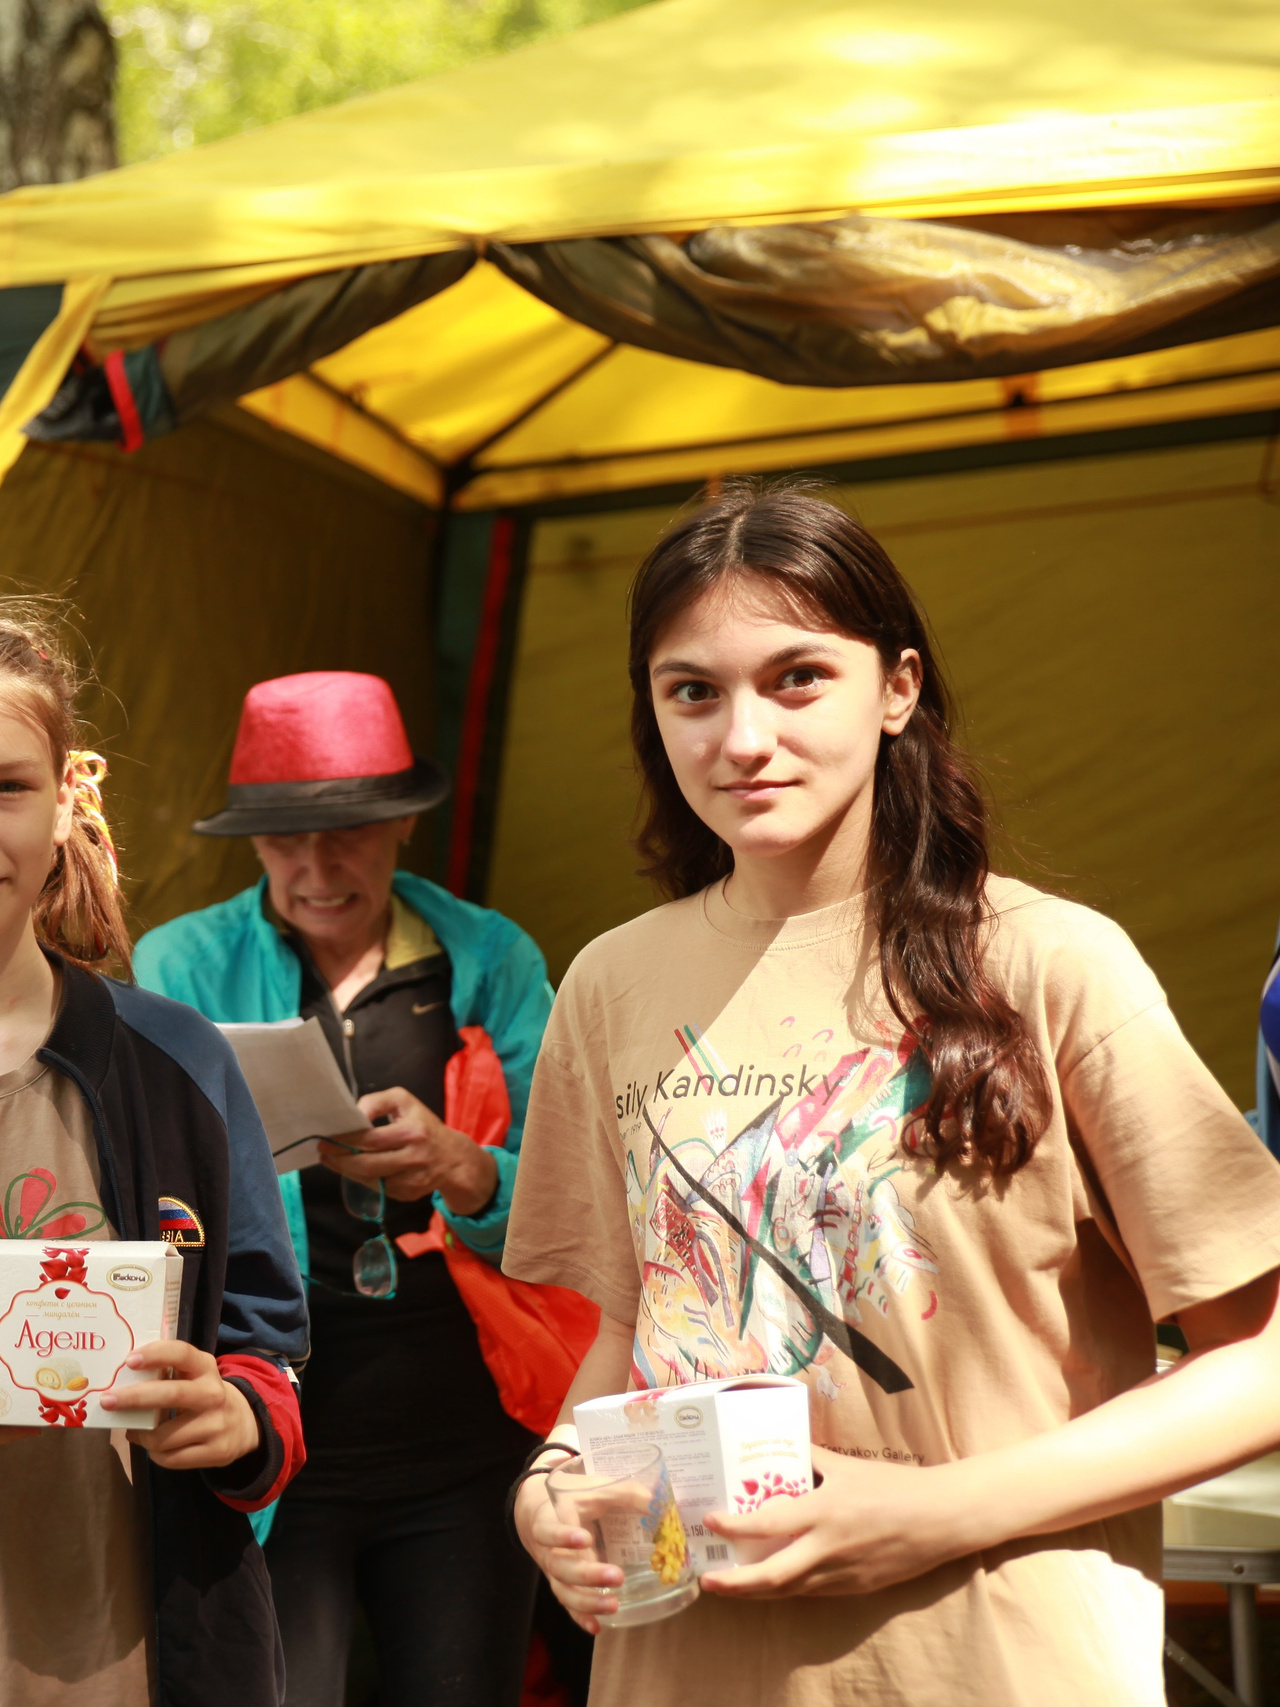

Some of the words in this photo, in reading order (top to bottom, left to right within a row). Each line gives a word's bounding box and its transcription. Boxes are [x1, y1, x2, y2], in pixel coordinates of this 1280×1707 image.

[653, 1064, 843, 1105] Kandinsky
[14, 1319, 106, 1358] Адель
[881, 1447, 925, 1466] Gallery
[691, 1524, 704, 1537] 150
